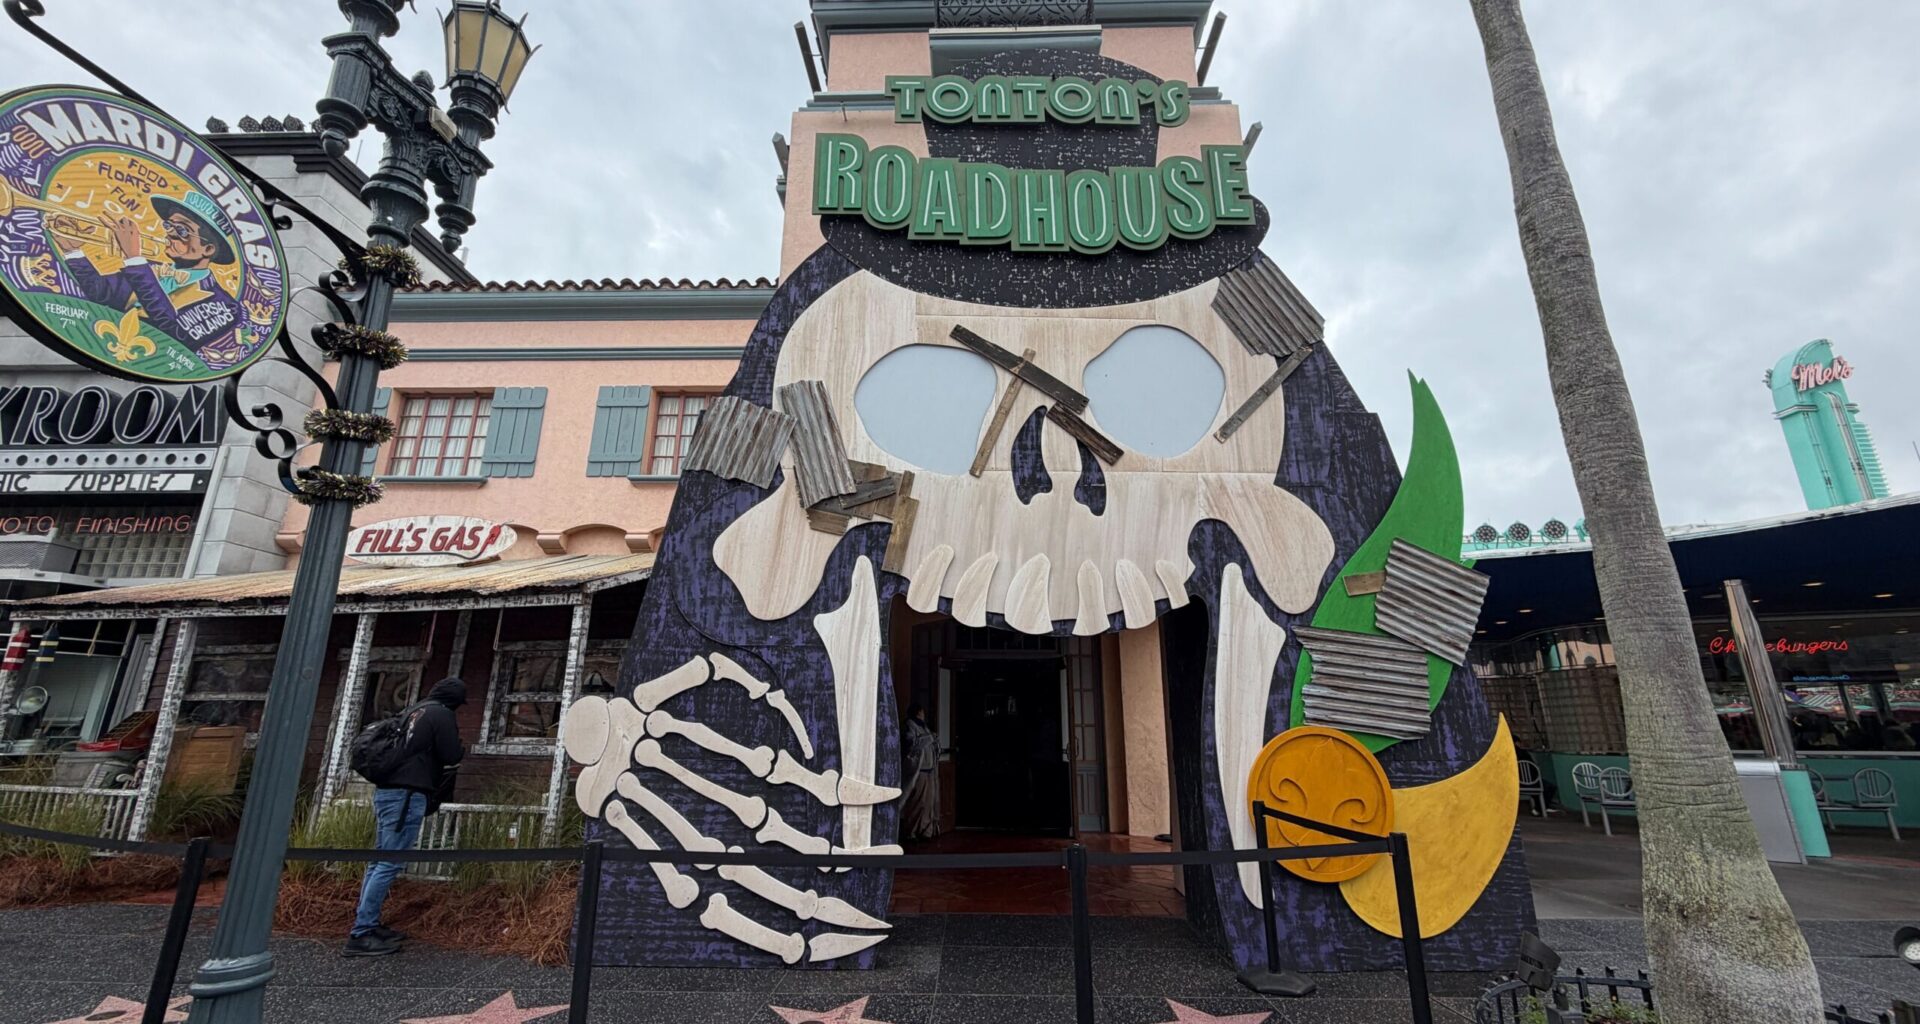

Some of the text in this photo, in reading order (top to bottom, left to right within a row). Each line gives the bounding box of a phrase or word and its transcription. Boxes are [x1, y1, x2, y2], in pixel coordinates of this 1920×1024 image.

[890, 78, 1186, 123] TONTON'S
[21, 103, 276, 269] MARDI GRAS
[98, 161, 151, 193] FLOATS
[127, 158, 168, 188] FOOD
[110, 186, 140, 211] FUN
[816, 134, 1252, 250] ROADHOUSE
[45, 302, 89, 320] FEBRUARY
[60, 317, 76, 328] 7TH
[176, 301, 231, 331] UNIVERSAL
[188, 312, 234, 340] ORLANDO
[175, 353, 196, 371] APRIL
[1791, 356, 1853, 391] Mel's
[65, 473, 175, 492] SUPPLIES
[0, 515, 192, 534] OTO FINISHING
[355, 523, 484, 553] FILL'S GAS
[1709, 636, 1849, 655] Cheburgers
